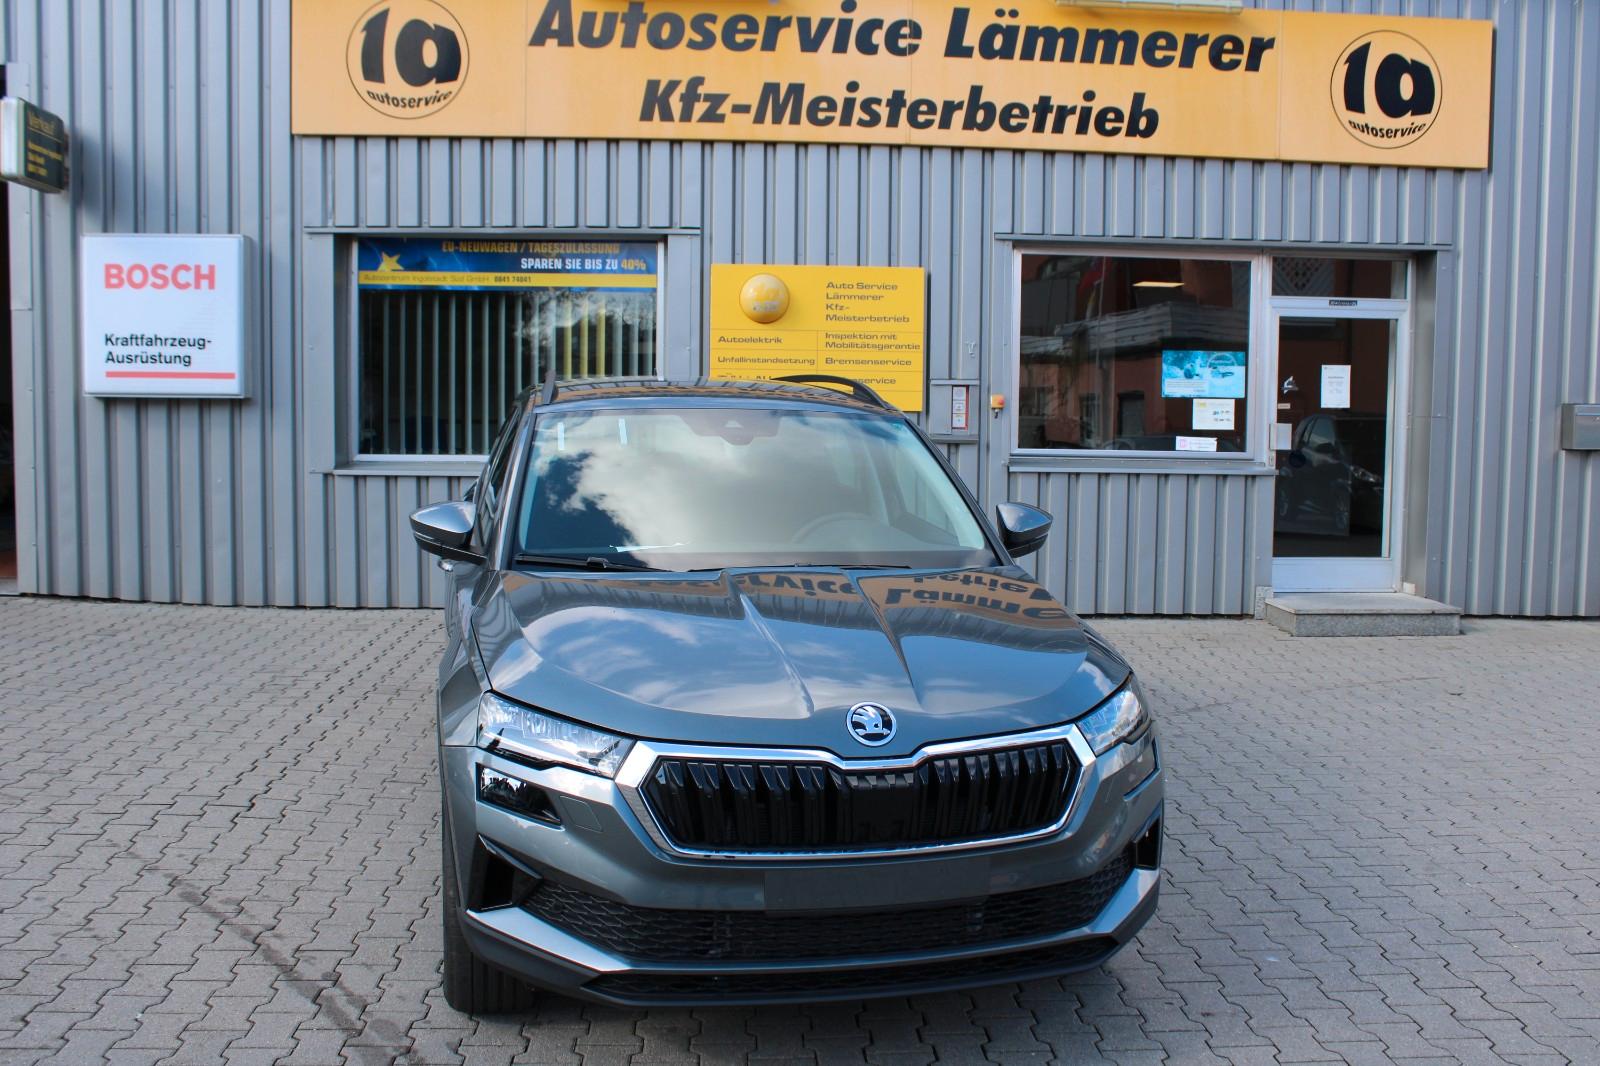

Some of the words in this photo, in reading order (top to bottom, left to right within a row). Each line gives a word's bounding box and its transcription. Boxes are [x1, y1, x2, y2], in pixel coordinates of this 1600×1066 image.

[528, 0, 923, 57] Autoservice
[944, 7, 1276, 73] Lämmerer
[361, 8, 461, 87] 1a
[1344, 40, 1435, 119] 1a
[366, 90, 452, 109] autoservice
[638, 75, 1160, 138] Kfz-Meisterbetrieb
[1348, 120, 1426, 139] autoservice
[528, 242, 620, 254] TAGESZULASSUNG
[521, 258, 561, 269] SPAREN
[565, 258, 582, 270] SIE
[585, 258, 602, 270] BIS
[605, 259, 618, 270] ZU
[621, 259, 647, 271] 40%
[104, 263, 216, 290] BOSCH
[825, 281, 855, 289] Auto
[857, 282, 898, 291] Service
[825, 292, 885, 301] Lämmerer
[825, 303, 850, 311] Kfz-
[825, 313, 910, 323] Meisterbetrieb
[104, 333, 212, 350] Kraftfahrzeug-
[718, 335, 783, 343] Autoelektrik
[825, 332, 878, 341] Inspektion
[825, 341, 920, 351] Mobilitätsgarantie
[105, 351, 192, 367] Ausrüstung
[717, 356, 816, 366] Unfallinstandsetzung
[825, 357, 912, 366] Bremsenservice
